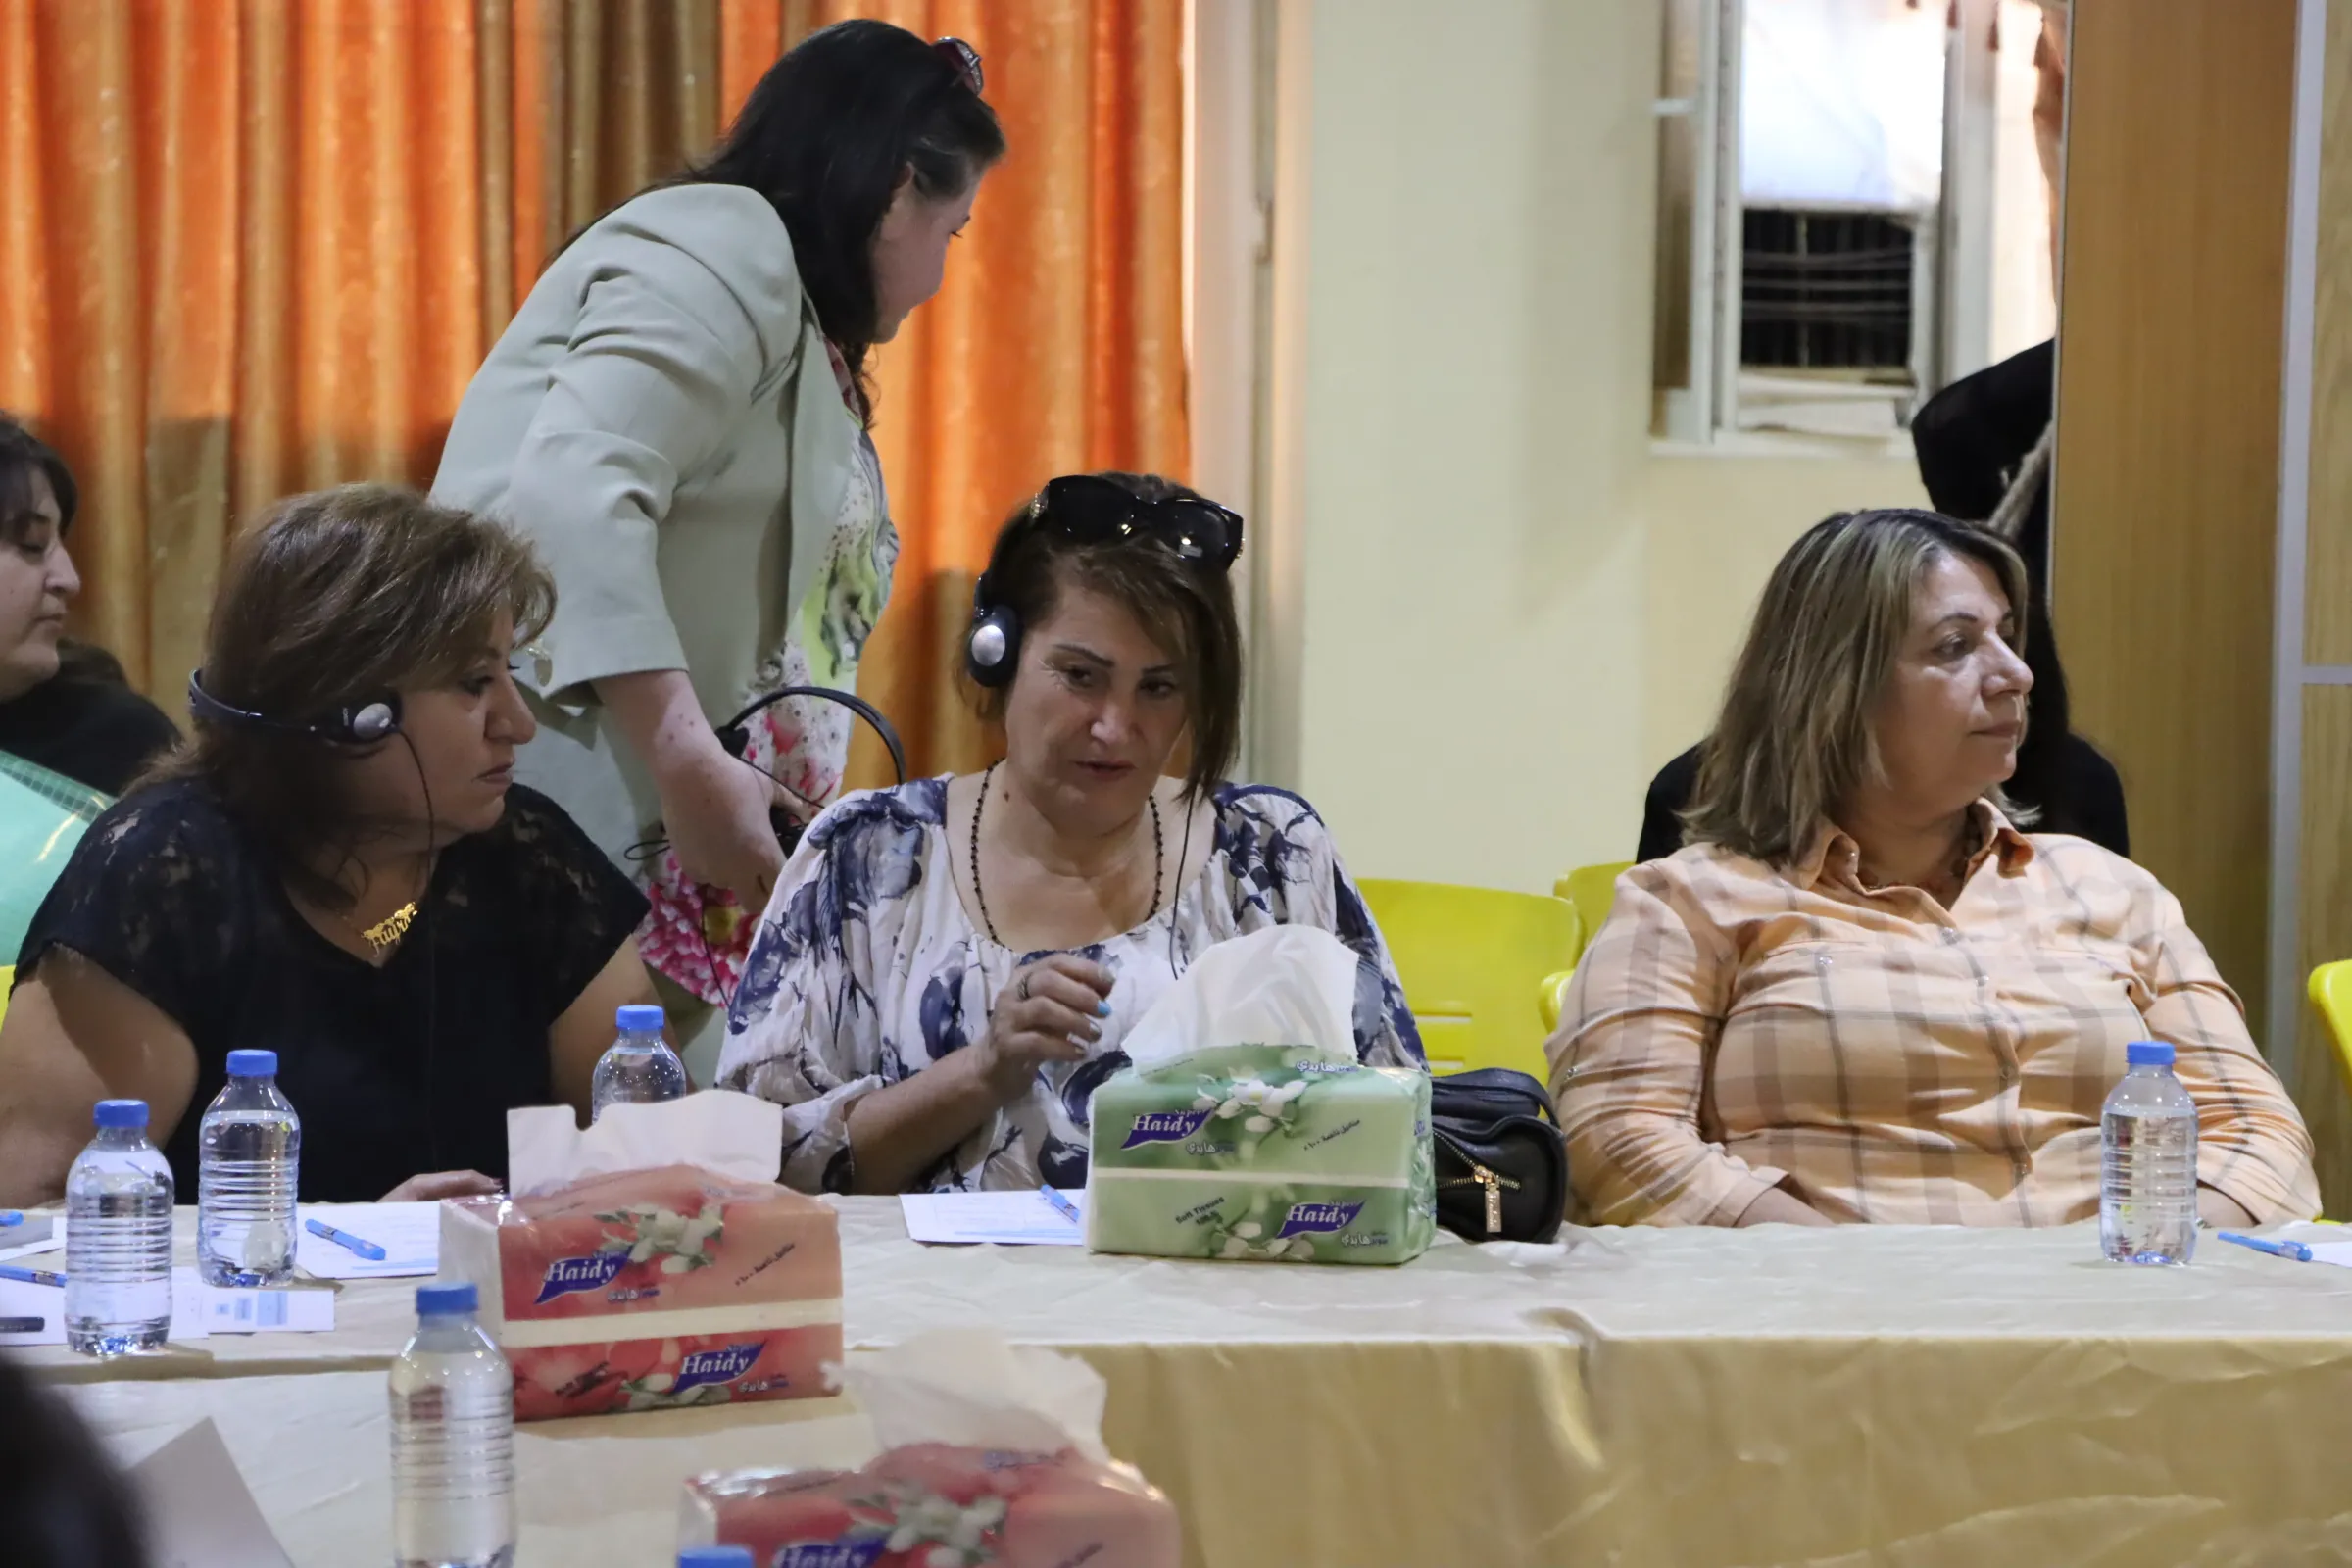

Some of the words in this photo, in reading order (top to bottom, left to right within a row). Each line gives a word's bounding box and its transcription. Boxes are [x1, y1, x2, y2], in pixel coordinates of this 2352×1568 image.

[1132, 1115, 1196, 1137] Haidy
[1287, 1205, 1349, 1229] Haidy
[547, 1260, 616, 1283] Haidy
[680, 1352, 750, 1377] Haidy
